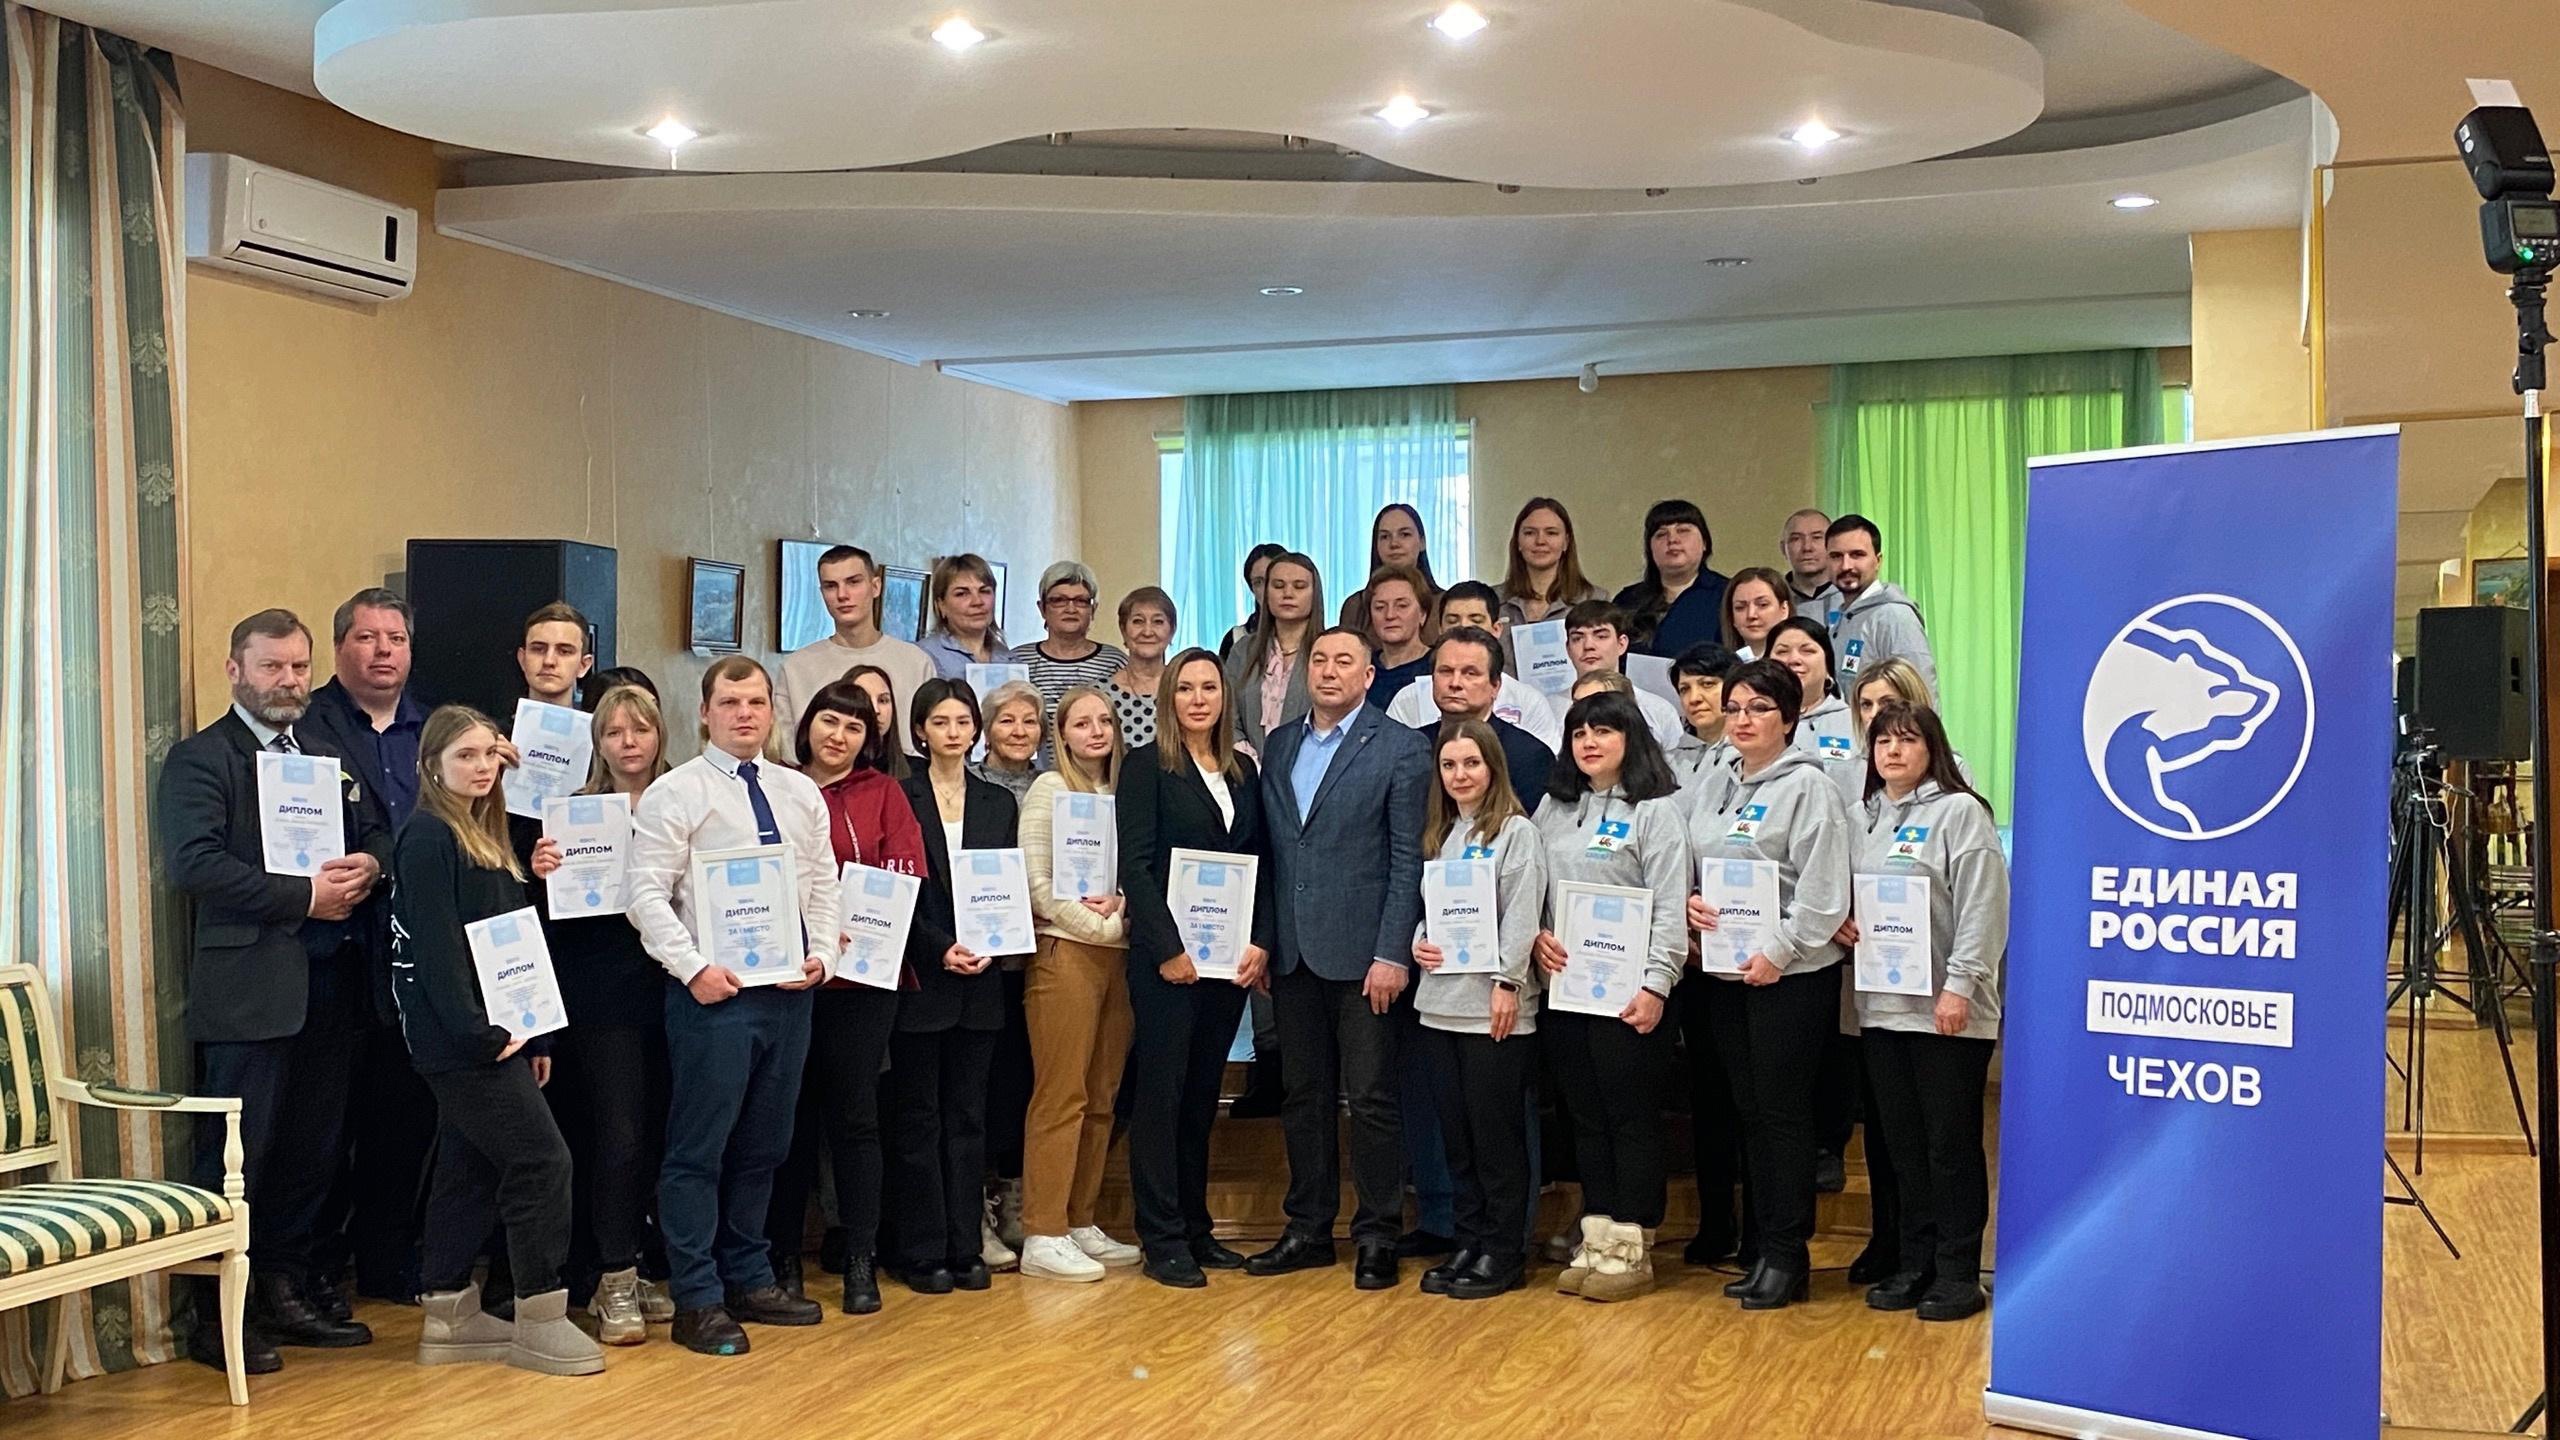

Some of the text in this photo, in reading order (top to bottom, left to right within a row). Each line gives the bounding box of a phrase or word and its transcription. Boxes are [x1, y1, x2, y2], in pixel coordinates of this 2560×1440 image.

[1532, 658, 1568, 670] ДИПЛОМ
[527, 747, 571, 766] ДИПЛОМ
[278, 804, 322, 816] ДИПЛОМ
[1066, 837, 1101, 847] ДИПЛОМ
[566, 845, 613, 857] ДИПЛОМ
[2092, 866, 2298, 909] ЕДИНАЯ
[970, 894, 1011, 904] ДИПЛОМ
[725, 905, 770, 918] ДИПЛОМ
[1190, 905, 1228, 915] ДИПЛОМ
[1442, 906, 1479, 917] ДИПЛОМ
[1719, 907, 1760, 917] ДИПЛОМ
[851, 913, 892, 929] ДИПЛОМ
[1873, 924, 1913, 934] ДИПЛОМ
[2089, 911, 2297, 959] РОССИЯ
[1583, 939, 1625, 953] ДИПЛОМ
[497, 962, 535, 981] ДИПЛОМ
[2101, 991, 2277, 1030] ПОДМОСКОВЬЕ
[2108, 1054, 2262, 1107] ЧЕХОВ
